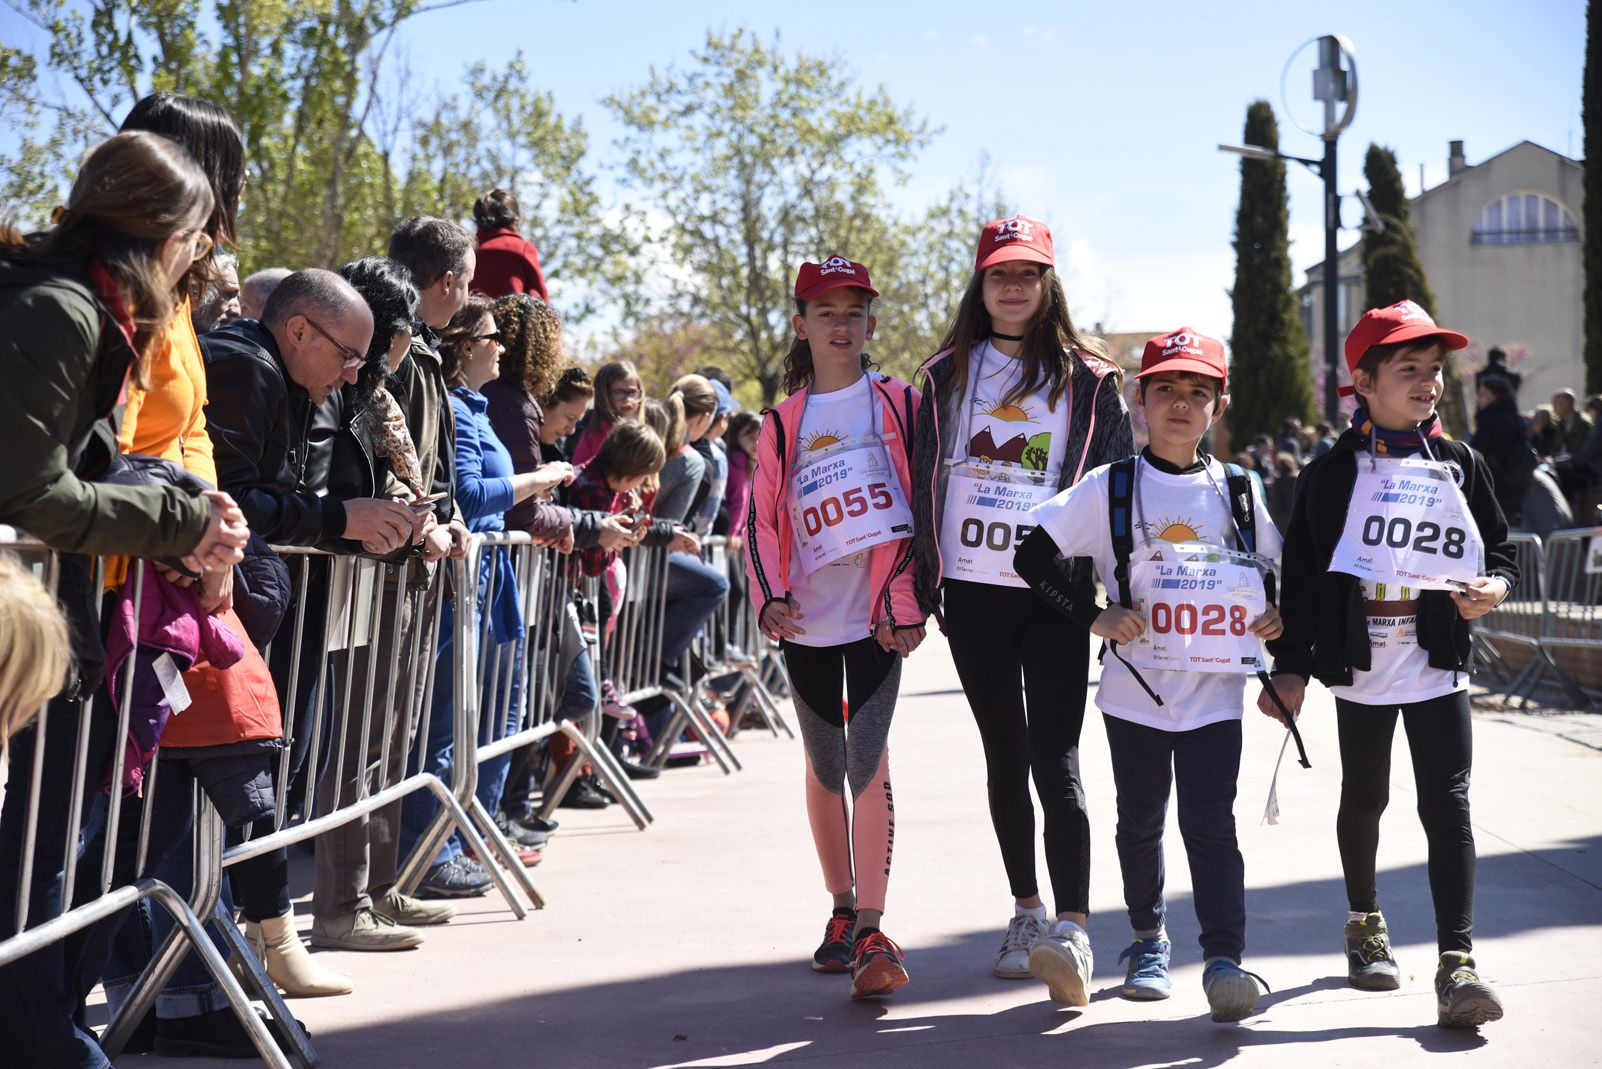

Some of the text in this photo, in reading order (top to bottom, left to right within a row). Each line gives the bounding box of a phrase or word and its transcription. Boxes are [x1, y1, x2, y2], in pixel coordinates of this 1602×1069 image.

[997, 219, 1034, 235] TOT
[819, 256, 852, 270] TOT
[1163, 332, 1204, 348] TOT
[811, 459, 846, 479] Marxa
[994, 485, 1033, 500] Marxa
[1398, 479, 1438, 495] Marxa
[802, 481, 894, 538] 0055
[960, 517, 1036, 553] 005
[1361, 515, 1466, 560] 0028
[1176, 565, 1217, 577] Marxa
[1039, 580, 1074, 612] KIPSTA
[1151, 602, 1248, 637] 0028
[1372, 617, 1396, 627] MARXA
